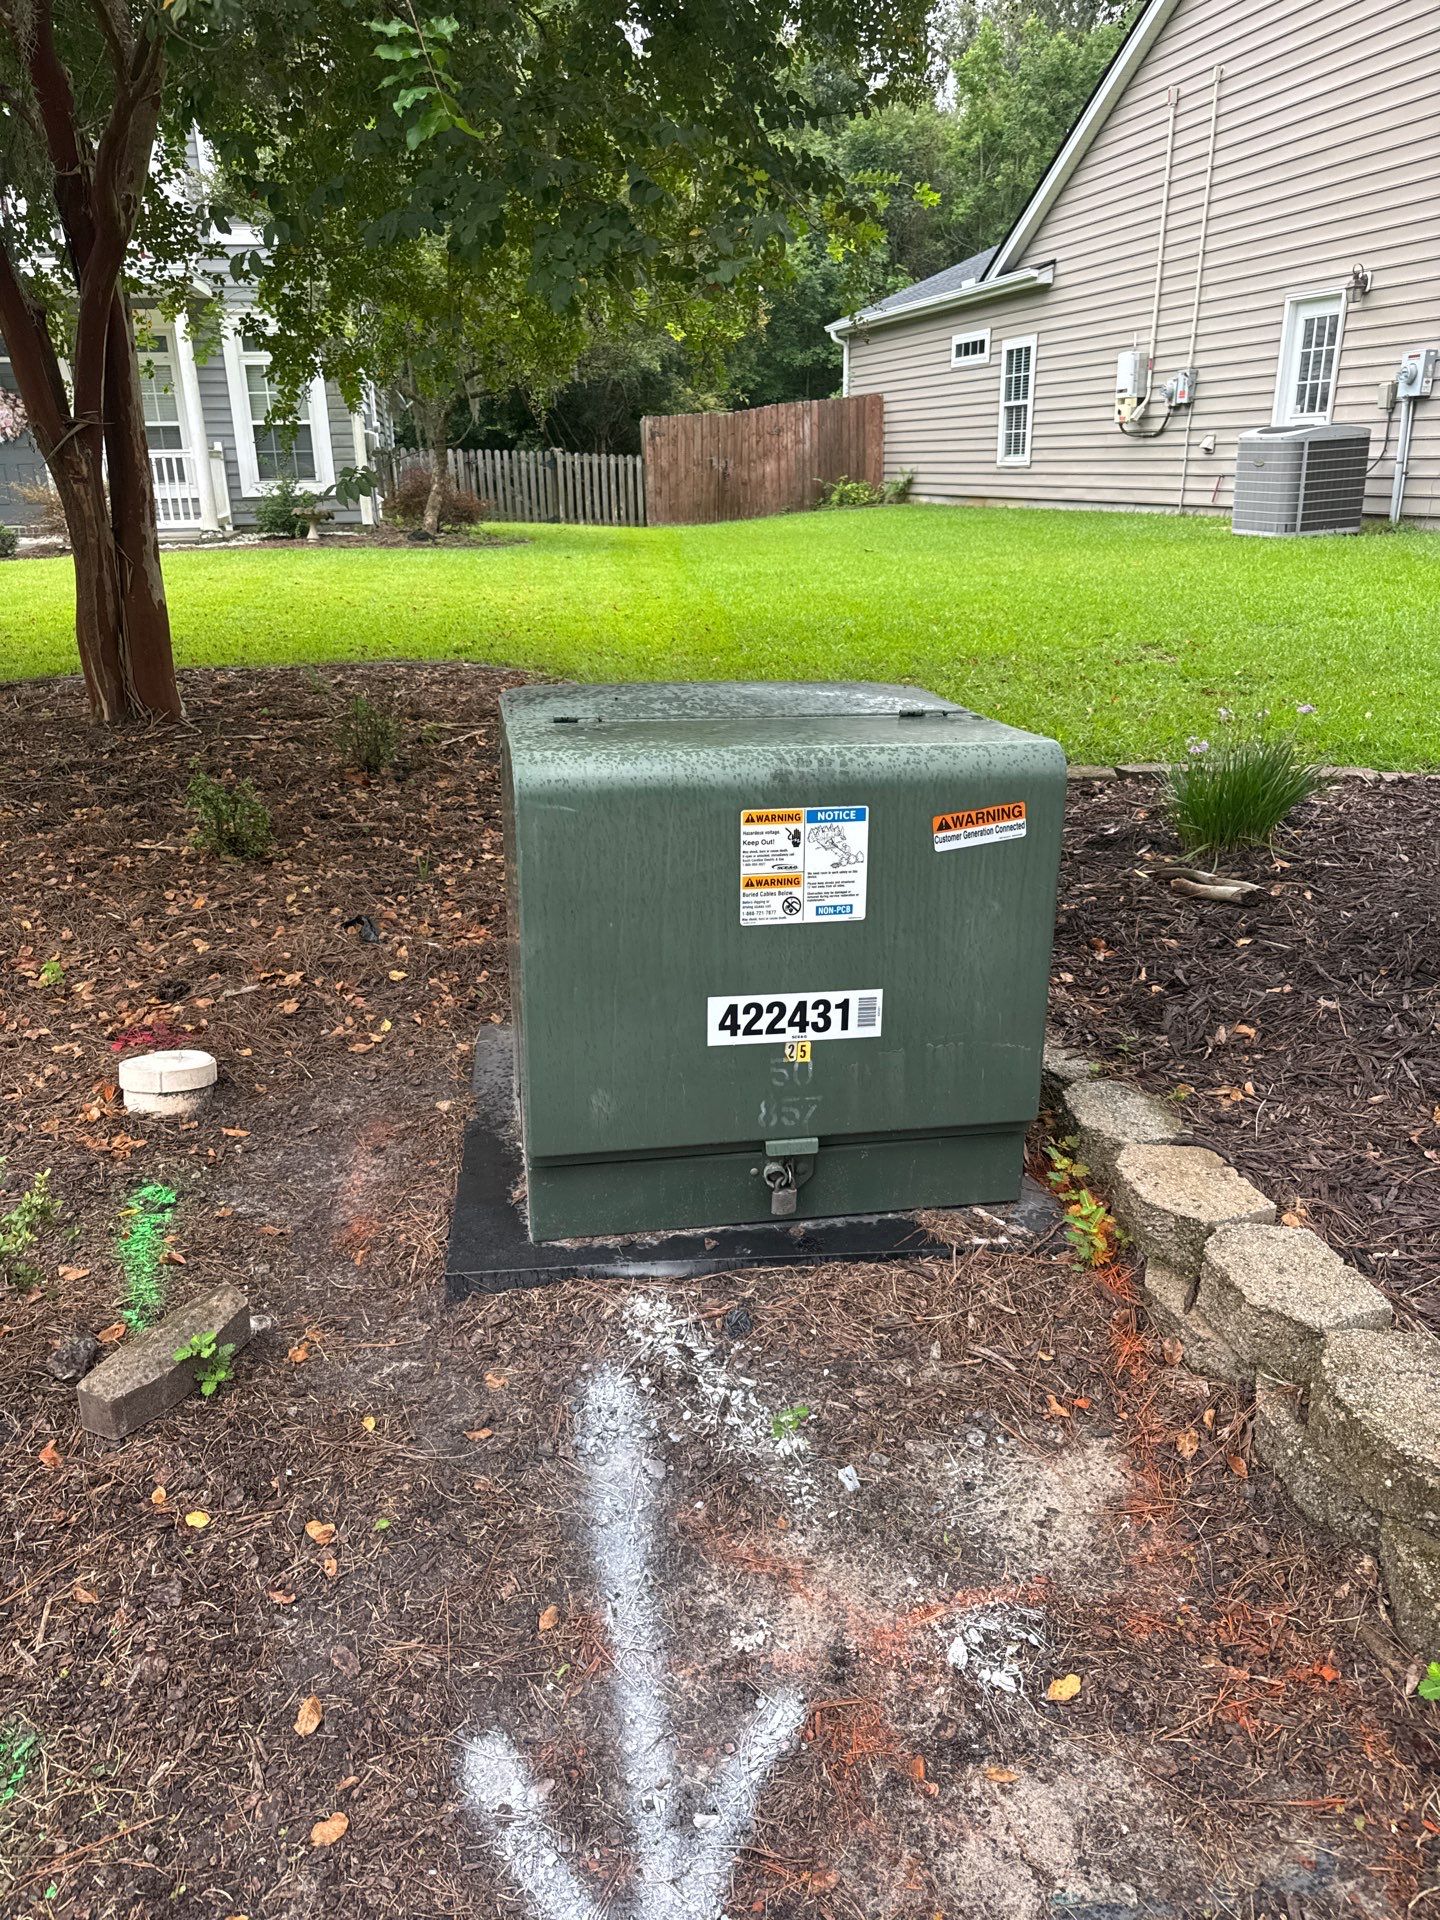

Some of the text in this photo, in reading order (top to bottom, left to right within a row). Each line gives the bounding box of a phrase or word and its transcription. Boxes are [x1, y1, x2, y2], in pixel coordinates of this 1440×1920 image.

[756, 813, 801, 823] WARNING
[817, 810, 857, 821] NOTICE
[951, 805, 1023, 828] WARNING
[934, 833, 962, 844] Customer
[963, 827, 995, 839] Generation
[995, 821, 1026, 834] Connected
[755, 877, 801, 887] WARNING
[818, 905, 851, 915] NON-PCB
[718, 998, 850, 1037] 422431
